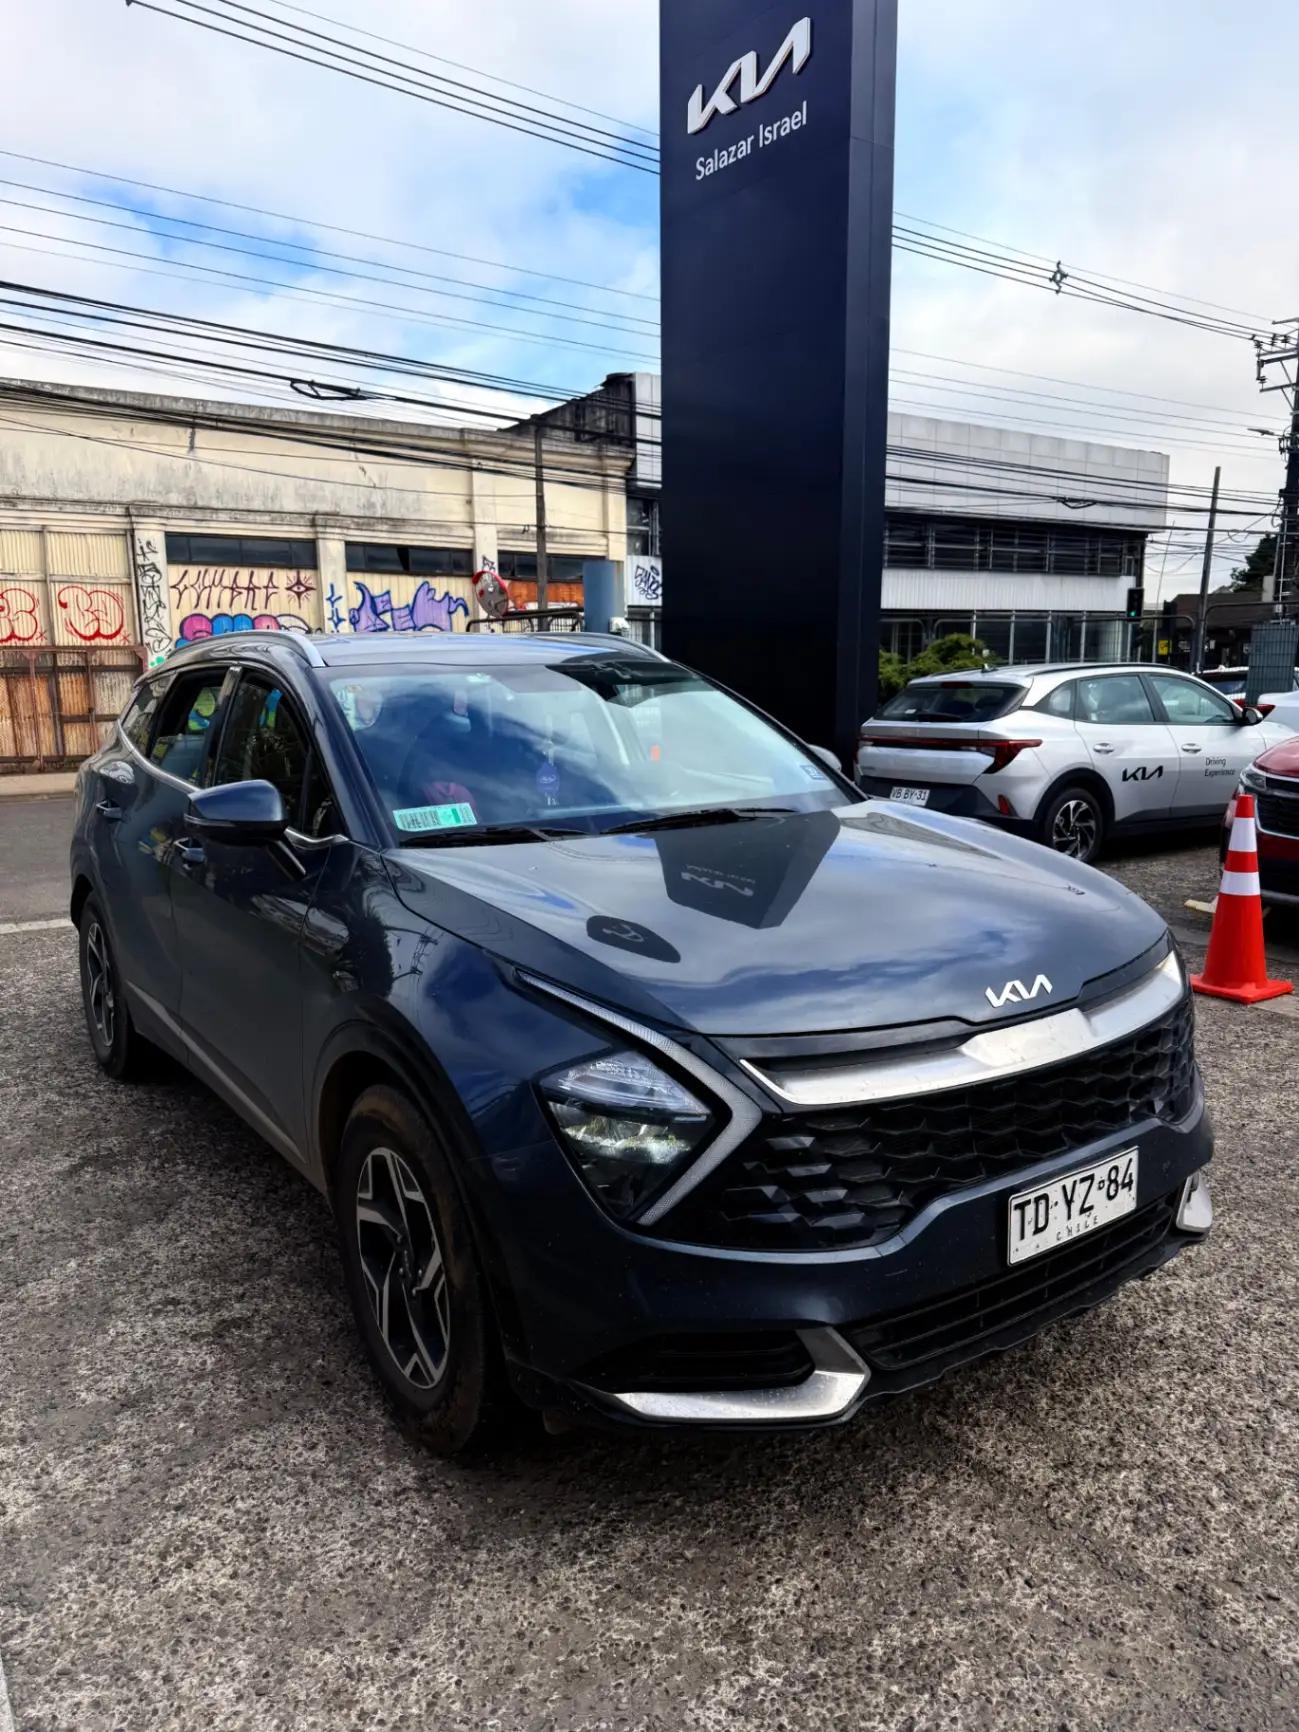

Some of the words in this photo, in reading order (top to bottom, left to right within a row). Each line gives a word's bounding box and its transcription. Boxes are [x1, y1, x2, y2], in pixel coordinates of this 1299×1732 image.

[687, 16, 811, 134] KIA
[695, 135, 754, 180] Salazar
[758, 100, 807, 148] Israel
[1122, 765, 1164, 782] KIA
[1205, 757, 1227, 767] Driving
[985, 973, 1053, 1008] KIA
